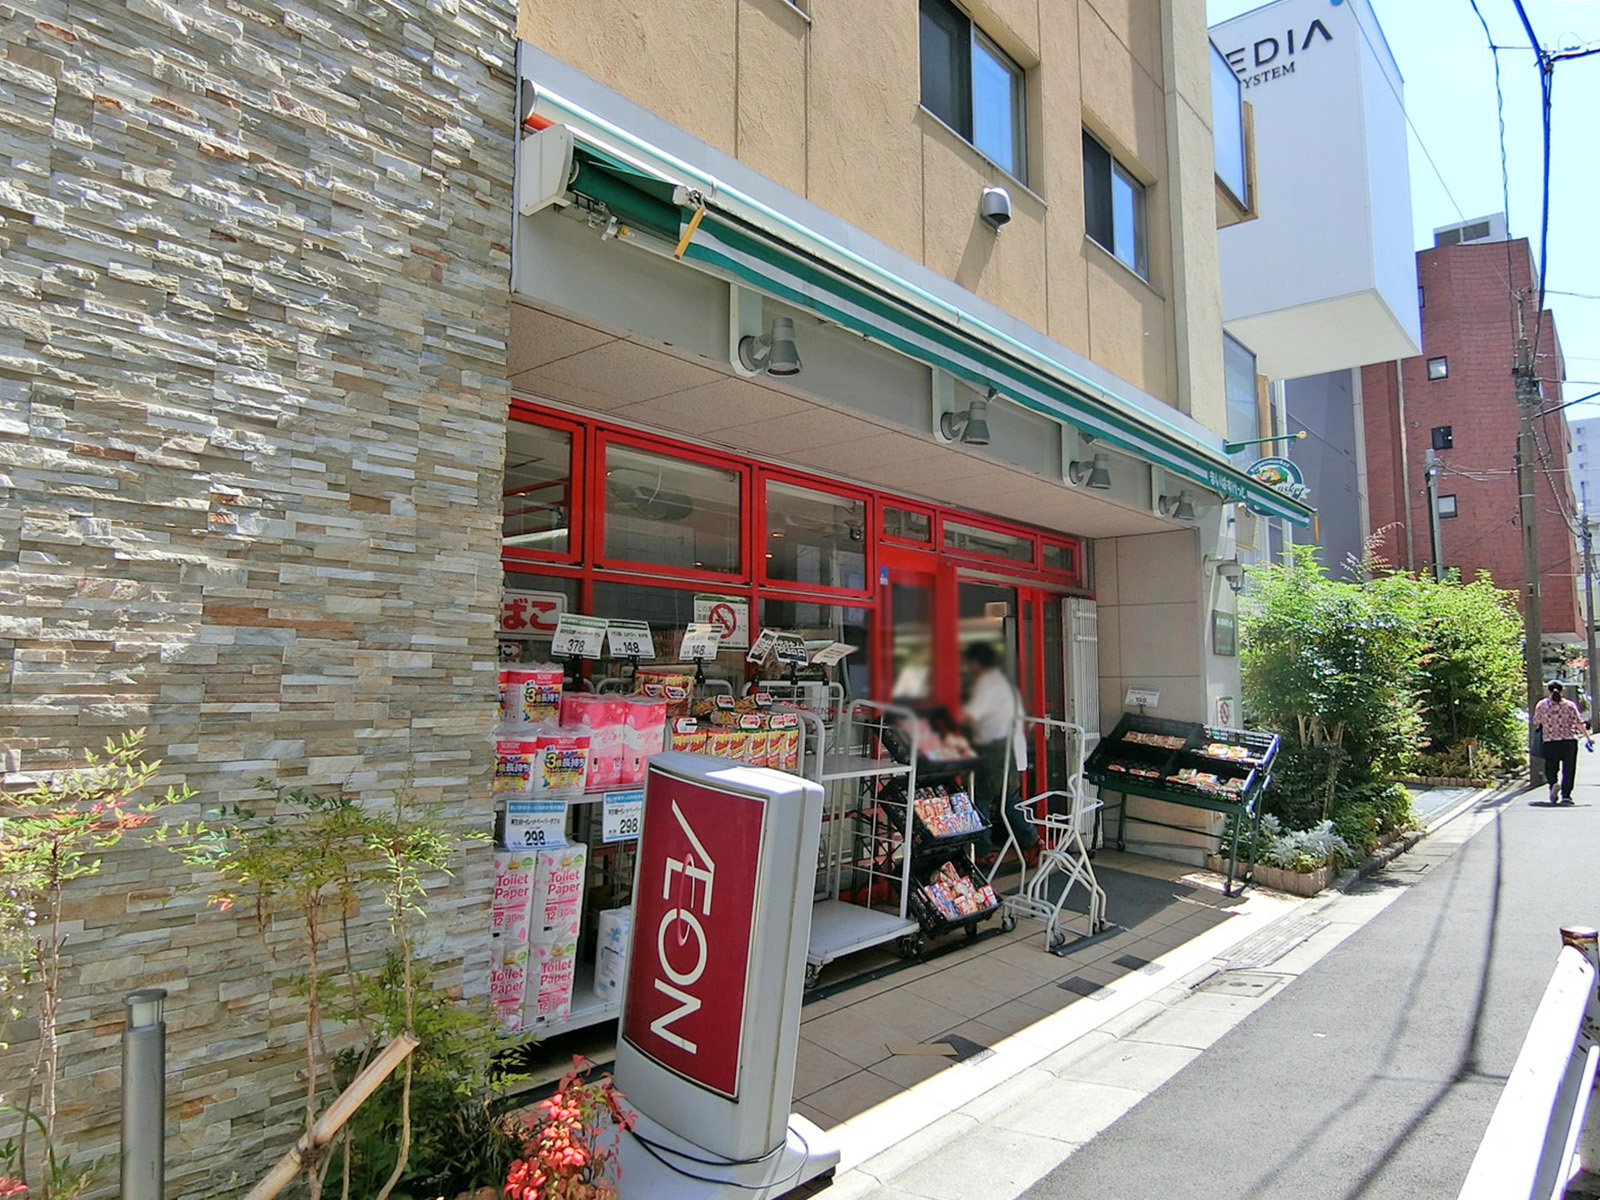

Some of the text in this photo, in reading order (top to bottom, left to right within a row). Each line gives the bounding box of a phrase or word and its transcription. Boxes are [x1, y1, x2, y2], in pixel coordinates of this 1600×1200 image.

[567, 638, 586, 653] 378
[623, 641, 640, 653] 148
[620, 817, 639, 834] 298
[524, 830, 546, 846] 298
[496, 873, 529, 887] Toilet
[548, 869, 581, 883] Toilet
[494, 887, 529, 900] Paper
[547, 883, 580, 895] Paper
[541, 959, 572, 973] Toilet
[491, 968, 523, 982] Toilet
[540, 972, 572, 986] Paper
[490, 981, 524, 995] Paper
